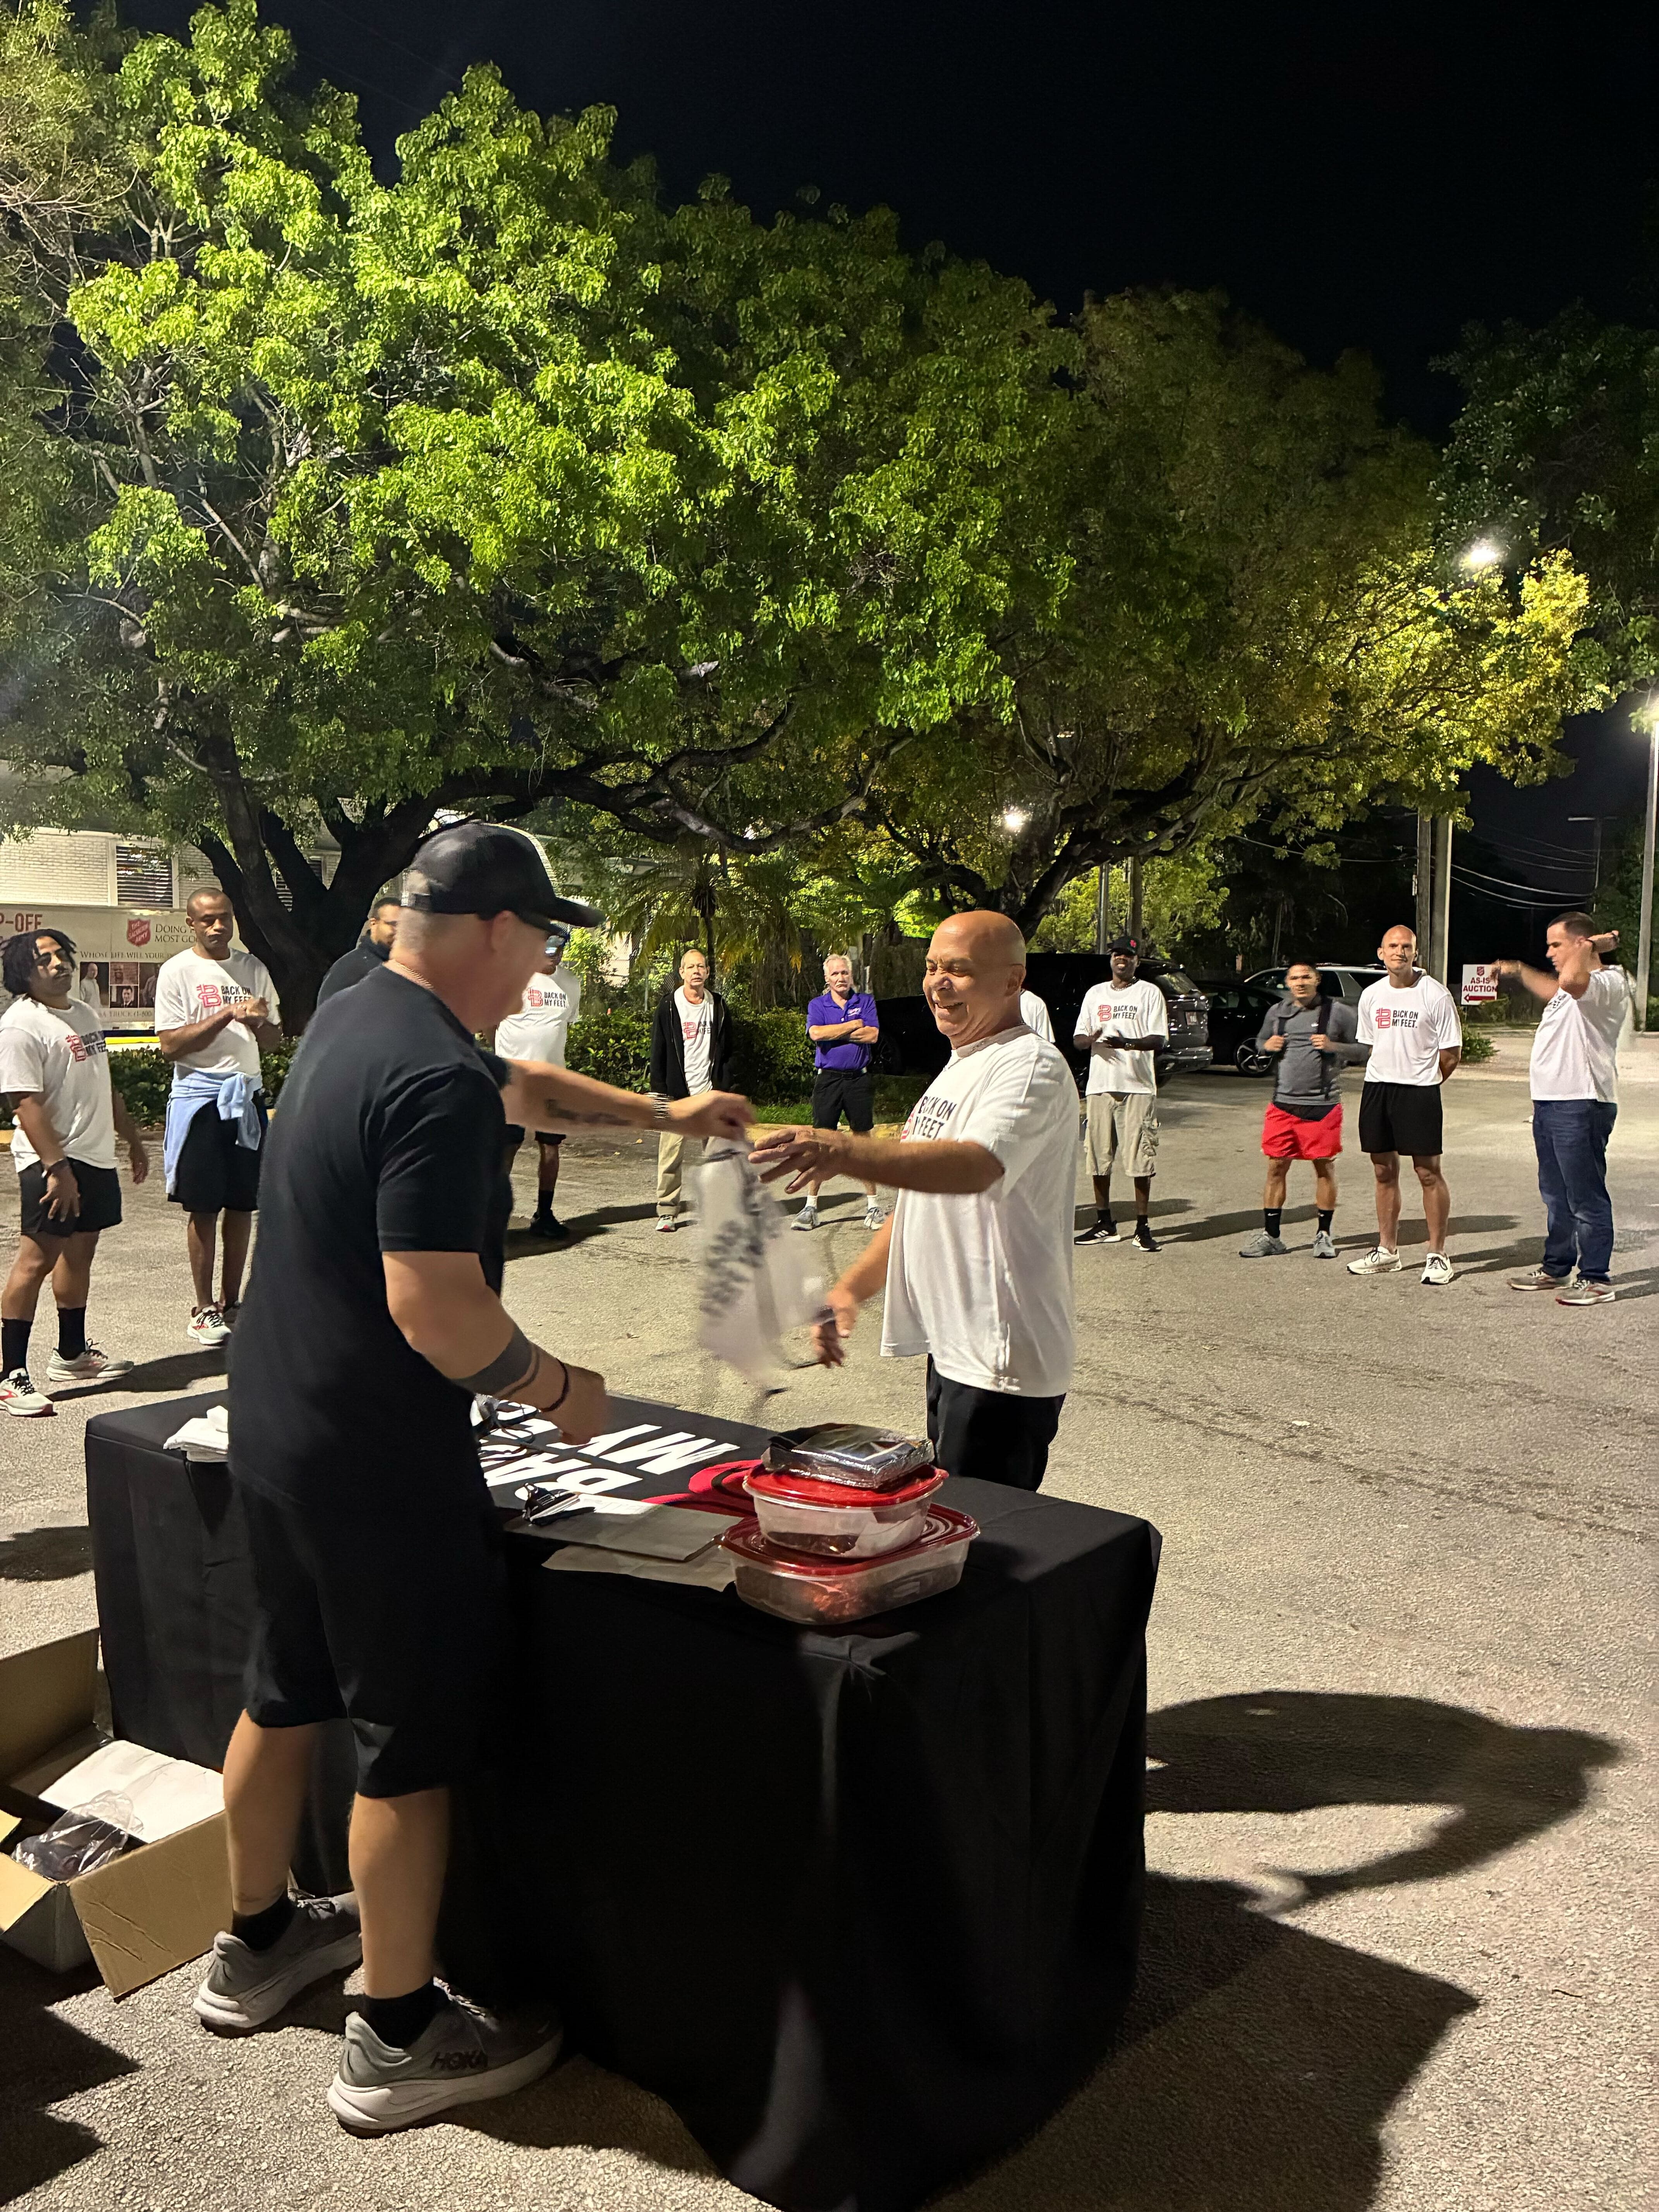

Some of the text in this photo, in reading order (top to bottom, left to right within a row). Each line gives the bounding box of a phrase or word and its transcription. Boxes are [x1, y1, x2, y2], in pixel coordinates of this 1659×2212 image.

[156, 924, 186, 933] DOING
[221, 986, 240, 995] BACK
[1393, 1010, 1418, 1019] BACK ON
[1401, 1019, 1417, 1028] FEET.
[936, 1100, 957, 1121] ON
[429, 2050, 488, 2070] HOKA
